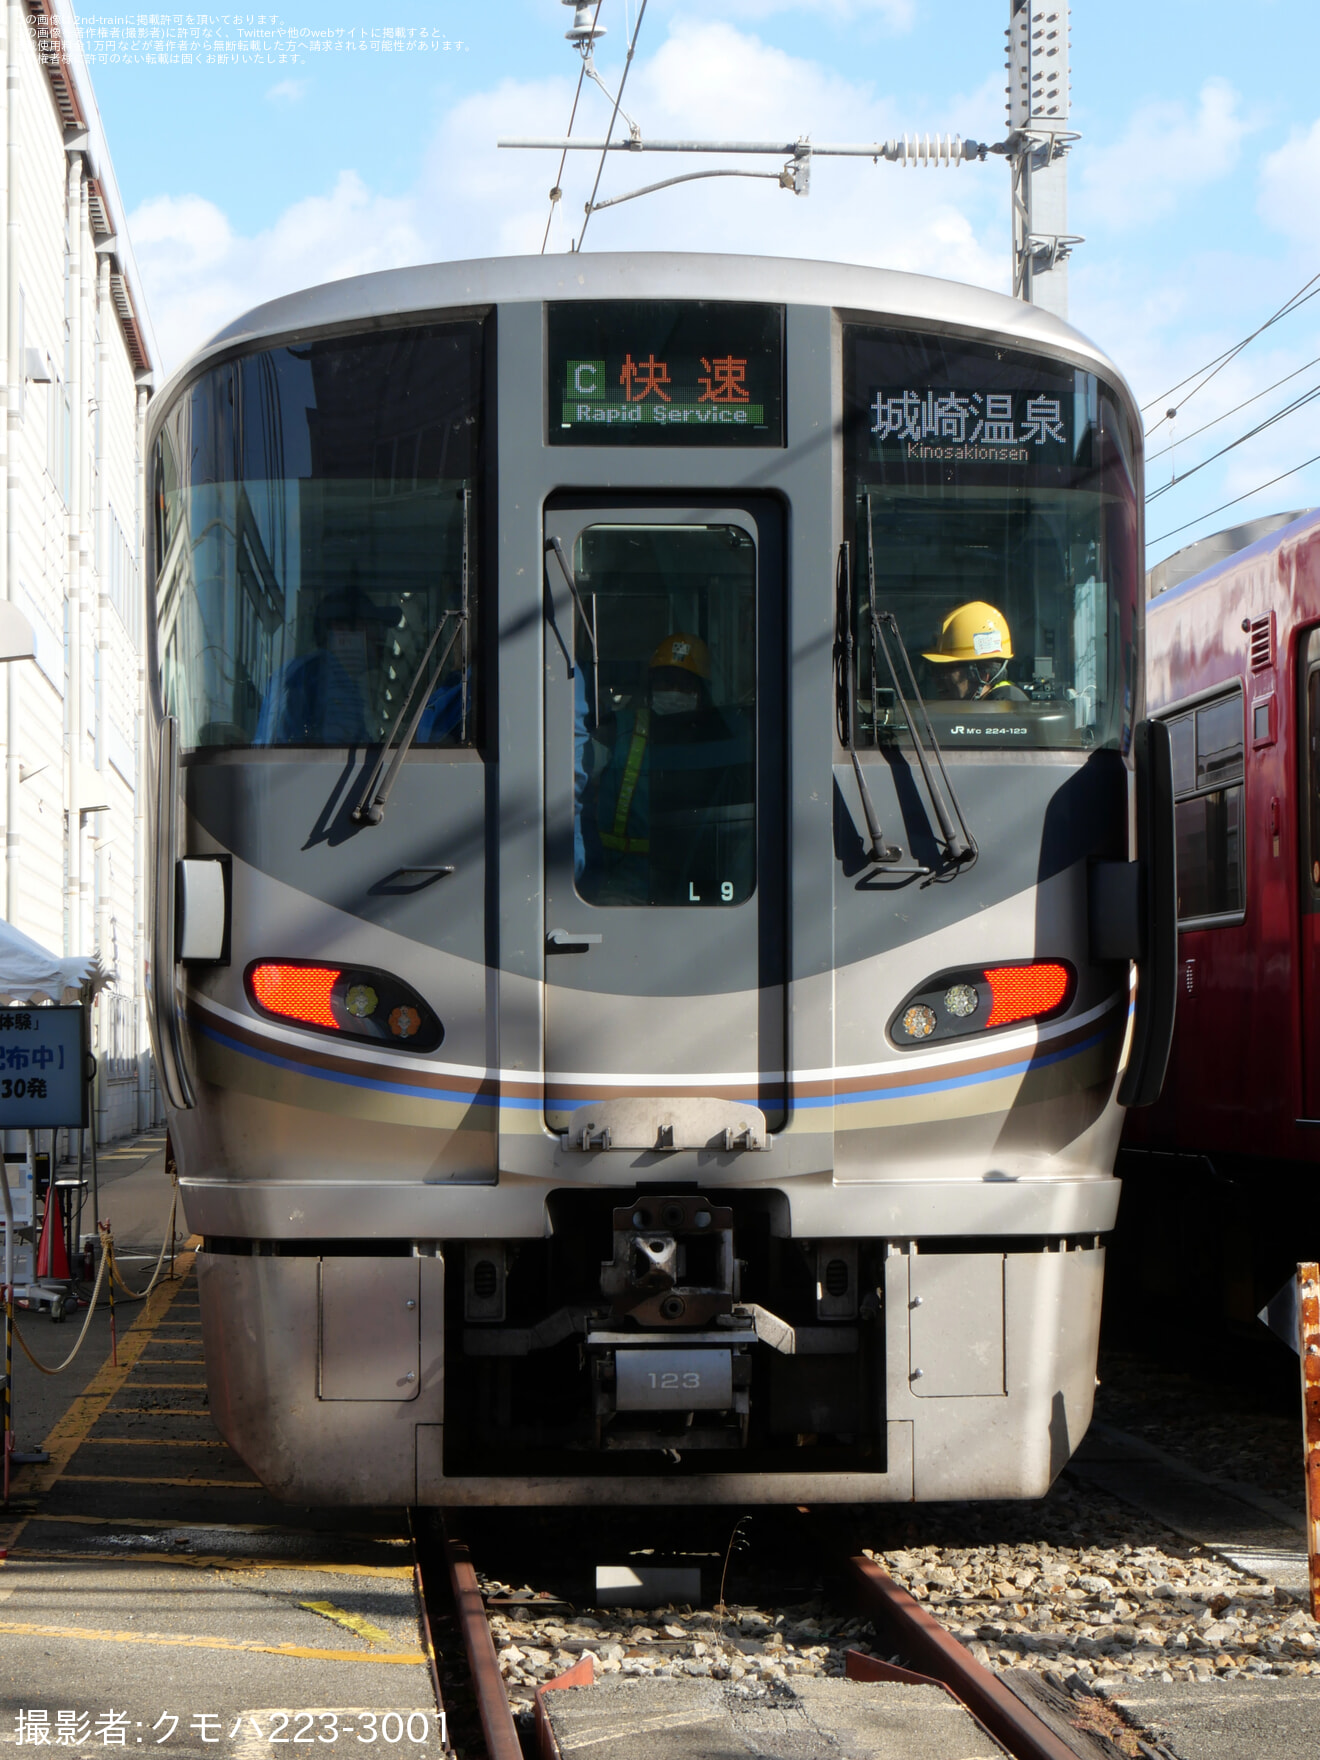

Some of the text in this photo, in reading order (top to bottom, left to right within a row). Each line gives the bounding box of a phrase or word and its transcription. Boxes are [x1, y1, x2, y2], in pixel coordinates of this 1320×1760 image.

[574, 353, 750, 403] C 快速
[576, 404, 748, 423] Rapid Service
[870, 390, 1067, 445] 城崎温泉
[906, 442, 1029, 461] Kinosakionsen
[950, 725, 965, 735] JR
[985, 727, 1028, 735] 224-123
[688, 881, 734, 902] L 9
[647, 1372, 701, 1389] 123
